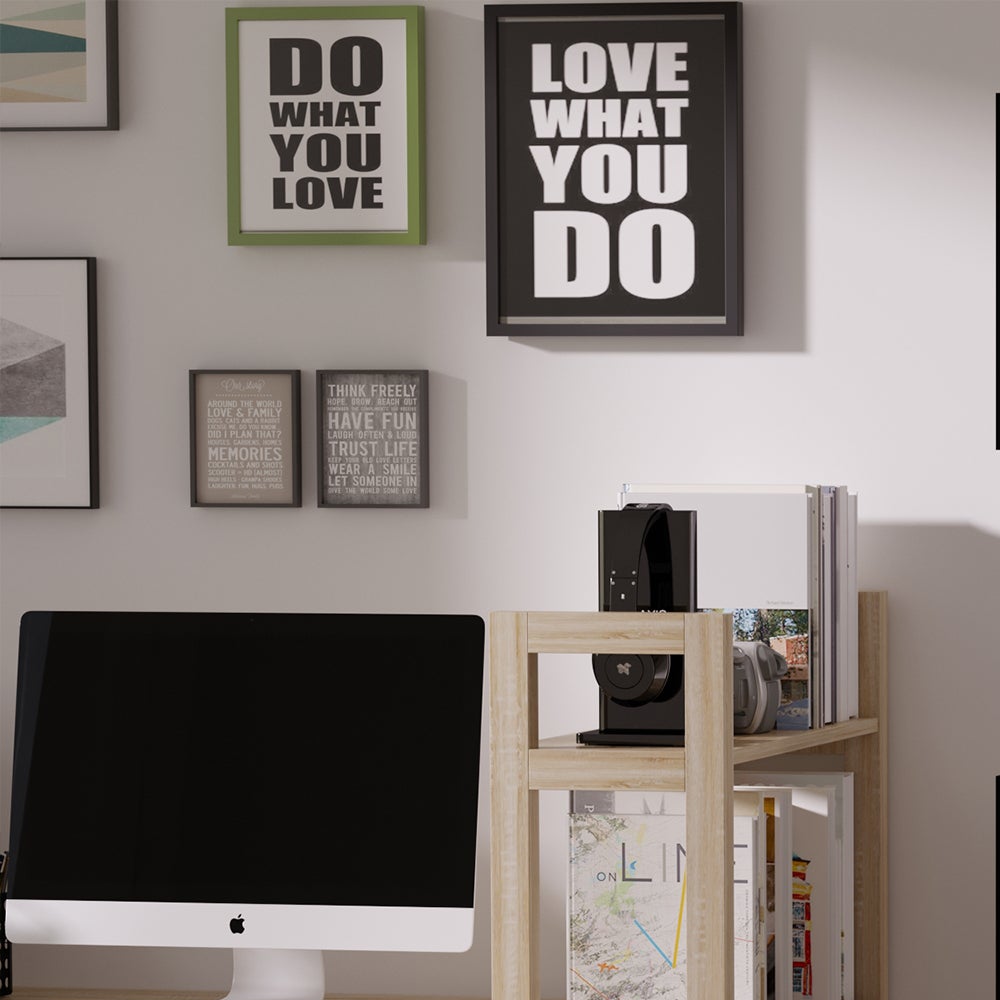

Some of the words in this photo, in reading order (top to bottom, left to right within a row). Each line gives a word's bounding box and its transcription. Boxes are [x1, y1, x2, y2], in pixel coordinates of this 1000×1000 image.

[269, 36, 384, 96] DO
[531, 41, 689, 93] LOVE
[269, 101, 382, 128] WHAT
[529, 98, 689, 139] WHAT
[269, 132, 382, 173] YOU
[529, 143, 688, 205] YOU
[272, 177, 384, 210] LOVE
[533, 208, 696, 300] DO
[328, 384, 366, 397] THINK
[371, 384, 417, 397] FREELY
[208, 400, 238, 408] AROUND
[241, 400, 254, 408] THE
[256, 400, 282, 408] WORLD
[378, 398, 400, 406] REACH
[404, 398, 417, 406] OUT
[207, 408, 232, 418] LOVE
[236, 408, 244, 418] &
[247, 408, 282, 418] FAMILY
[328, 412, 374, 430] HAVE
[382, 412, 417, 430] FUN
[208, 430, 222, 439] DID
[224, 430, 227, 439] I
[230, 430, 253, 439] PLAN
[255, 430, 282, 439] THAT?
[328, 431, 354, 439] LAUGH
[358, 431, 384, 439] OFTEN
[387, 431, 393, 439] &
[396, 431, 417, 439] LOUD
[208, 447, 282, 461] MEMORIES
[328, 441, 378, 457] TRUST
[384, 441, 418, 457] LIFE
[328, 464, 361, 475] WEAR
[368, 464, 375, 475] A
[383, 464, 417, 475] SMILE
[328, 476, 348, 487] LET
[352, 476, 402, 487] SOMEONE
[406, 476, 417, 487] IN
